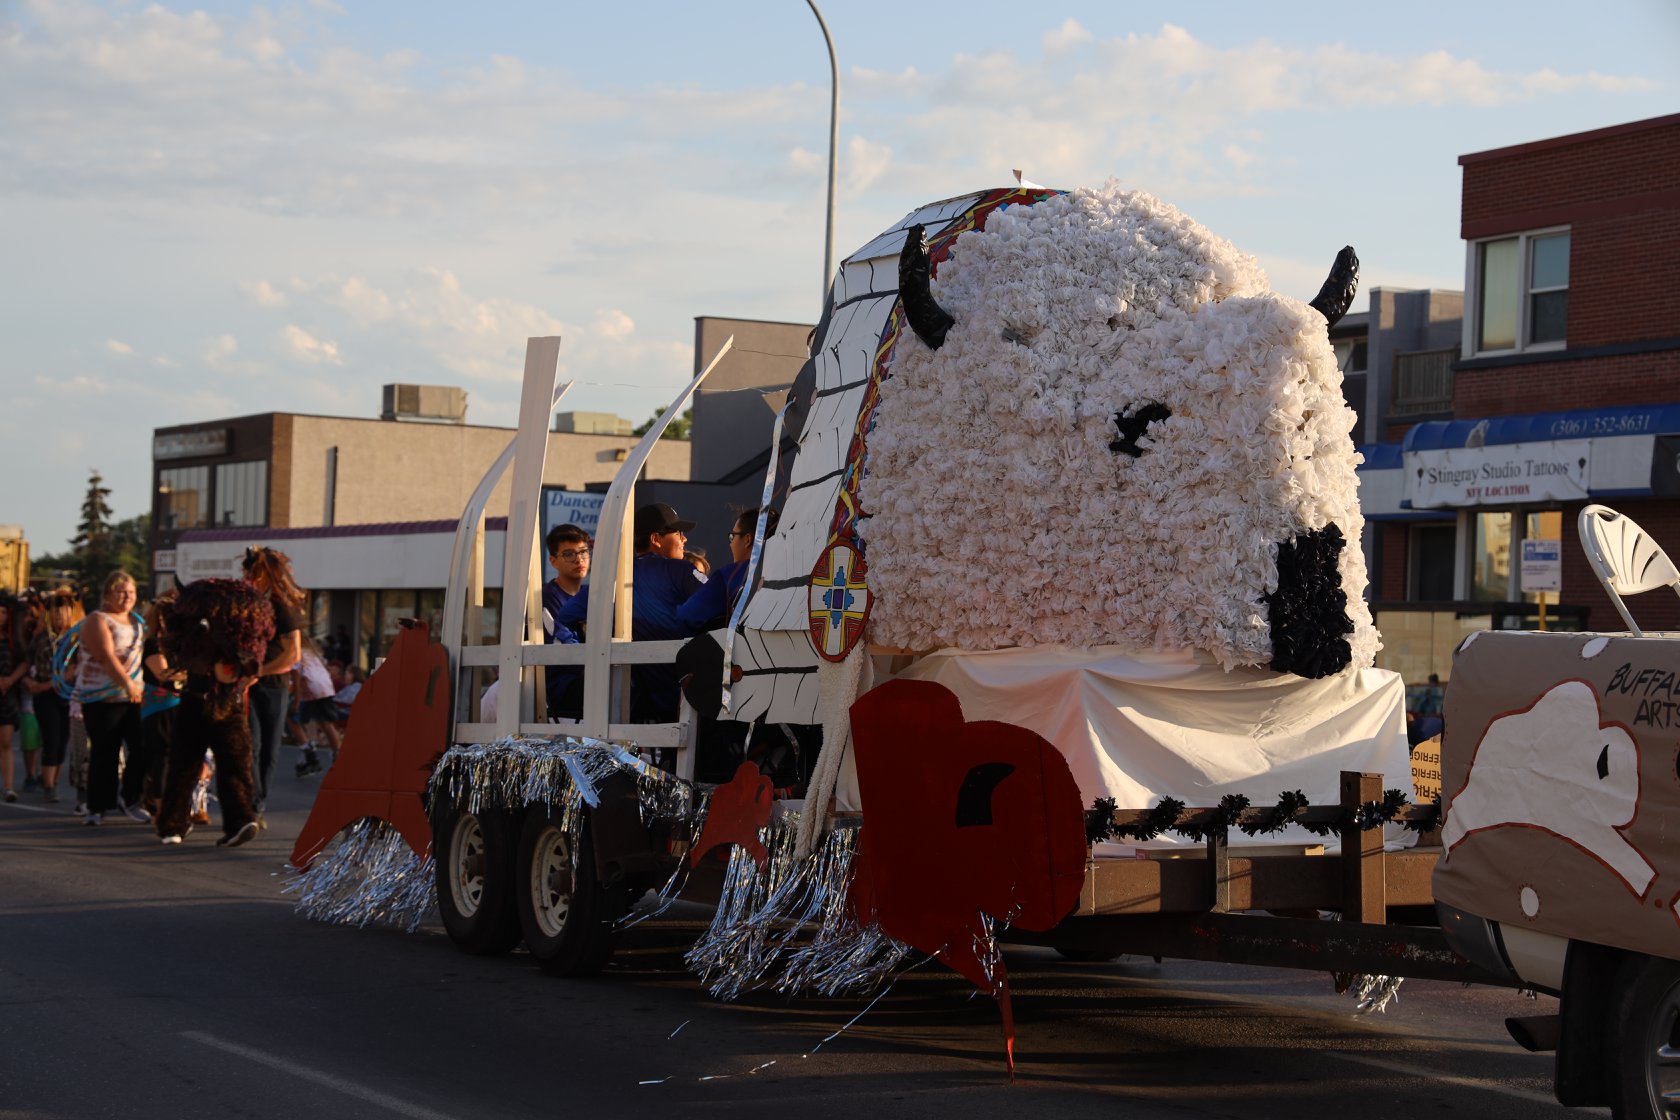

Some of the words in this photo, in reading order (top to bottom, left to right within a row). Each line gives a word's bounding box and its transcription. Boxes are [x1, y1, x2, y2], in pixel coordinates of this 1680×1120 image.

[1591, 414, 1651, 433] 352-8631
[1427, 465, 1478, 486] Stingray
[1482, 461, 1522, 480] Studio
[1525, 459, 1570, 476] Tattoos
[1485, 484, 1530, 496] LOCATION
